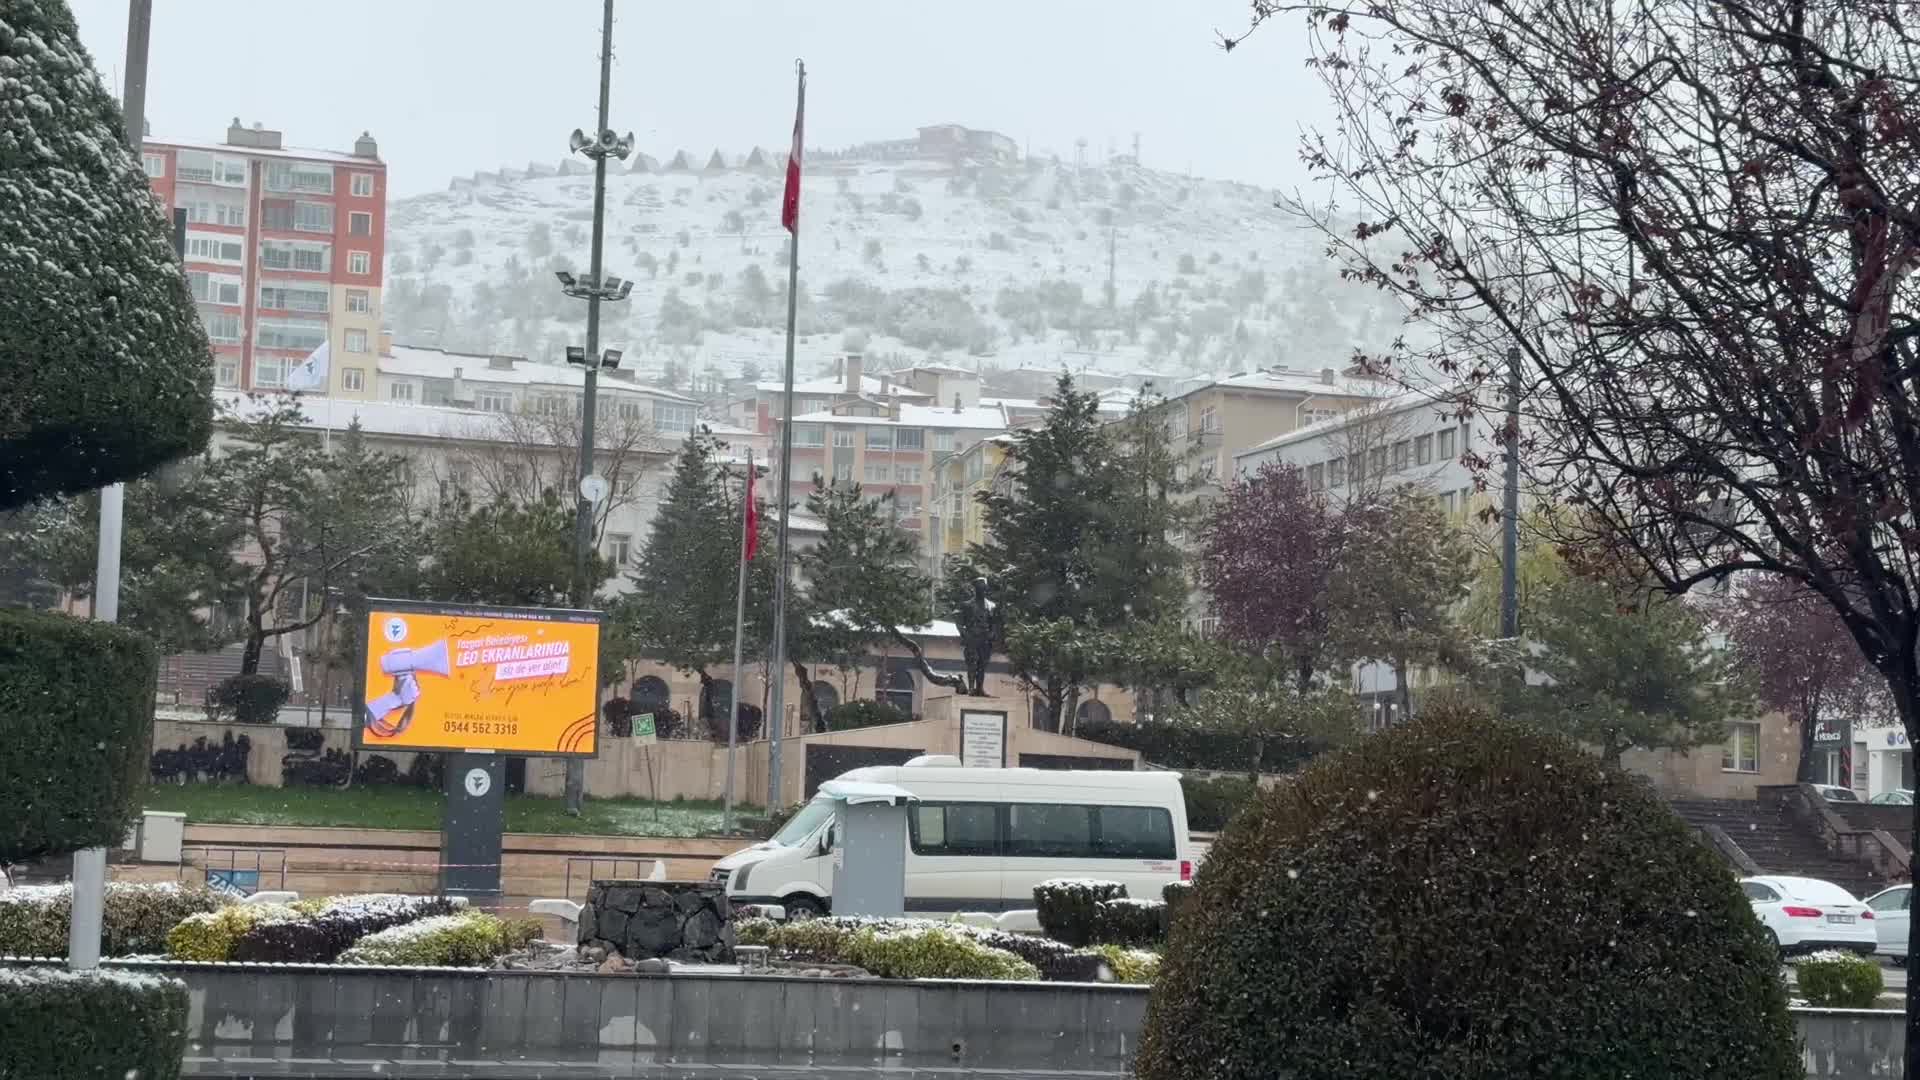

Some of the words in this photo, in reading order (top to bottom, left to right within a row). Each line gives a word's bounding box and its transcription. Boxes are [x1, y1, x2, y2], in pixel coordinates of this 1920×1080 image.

[456, 651, 478, 666] LED
[481, 641, 570, 663] EKRANLARINDA
[516, 663, 526, 673] de
[444, 721, 469, 732] 0544
[472, 722, 491, 734] 562
[494, 723, 518, 735] 3318
